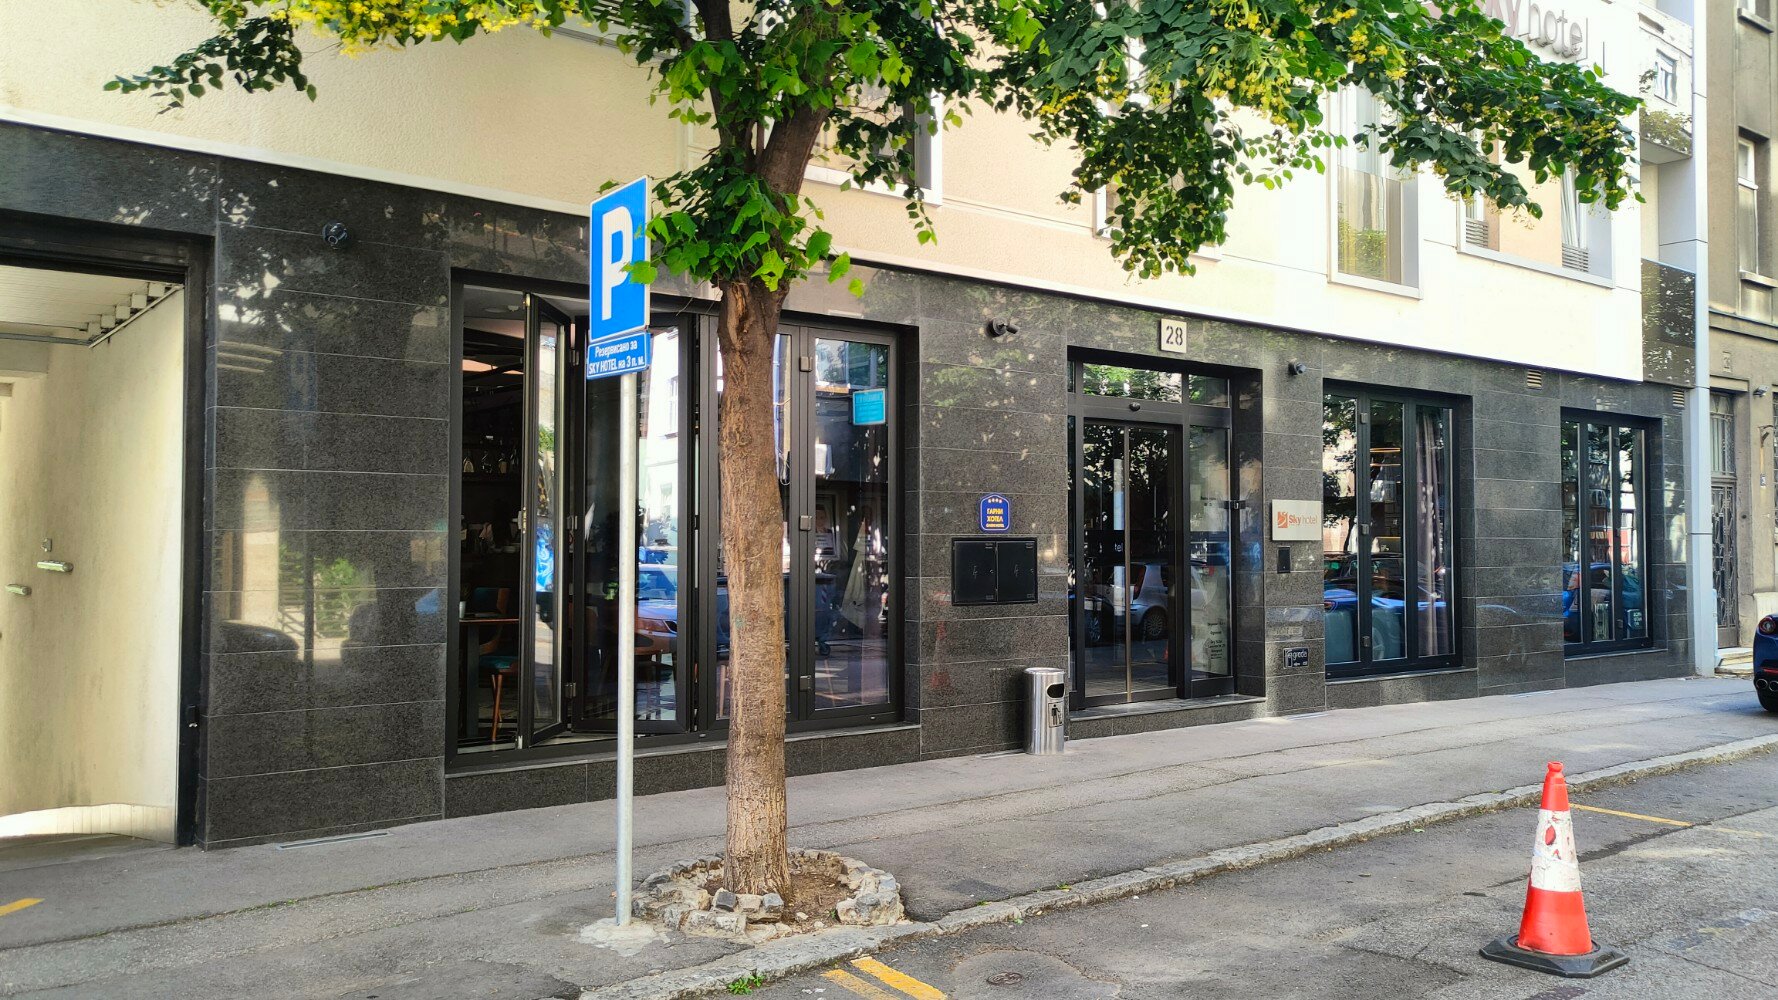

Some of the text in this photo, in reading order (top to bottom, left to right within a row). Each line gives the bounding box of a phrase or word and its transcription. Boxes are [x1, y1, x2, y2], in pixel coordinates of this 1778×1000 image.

[1528, 0, 1590, 62] hotel
[602, 206, 633, 320] P
[630, 340, 638, 350] за
[1166, 325, 1183, 346] 28
[589, 362, 600, 374] SKY
[600, 358, 617, 372] HOTEL
[618, 360, 625, 369] на
[626, 355, 631, 368] 3
[1288, 514, 1318, 525] Sky hotel
